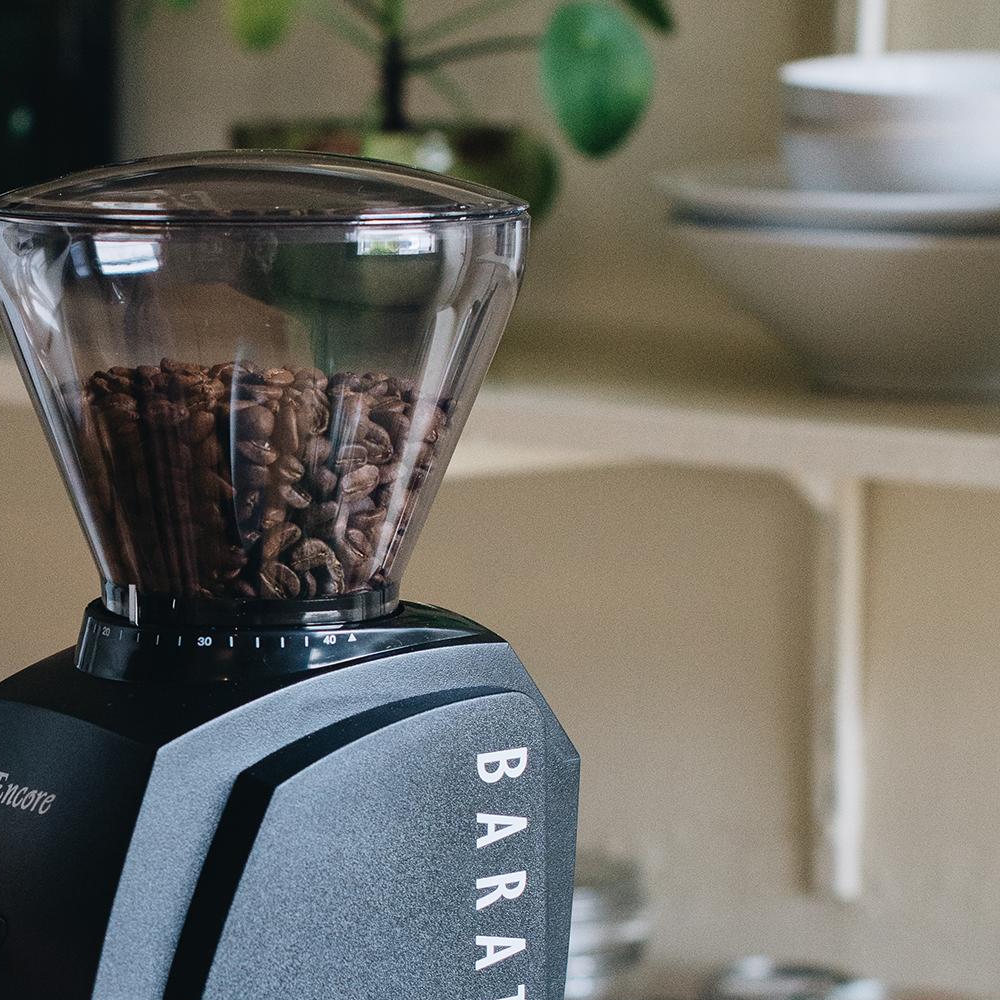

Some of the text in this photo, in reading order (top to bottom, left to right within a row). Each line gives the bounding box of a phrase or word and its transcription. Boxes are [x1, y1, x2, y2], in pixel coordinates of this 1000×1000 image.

[101, 626, 337, 647] 20 30 40
